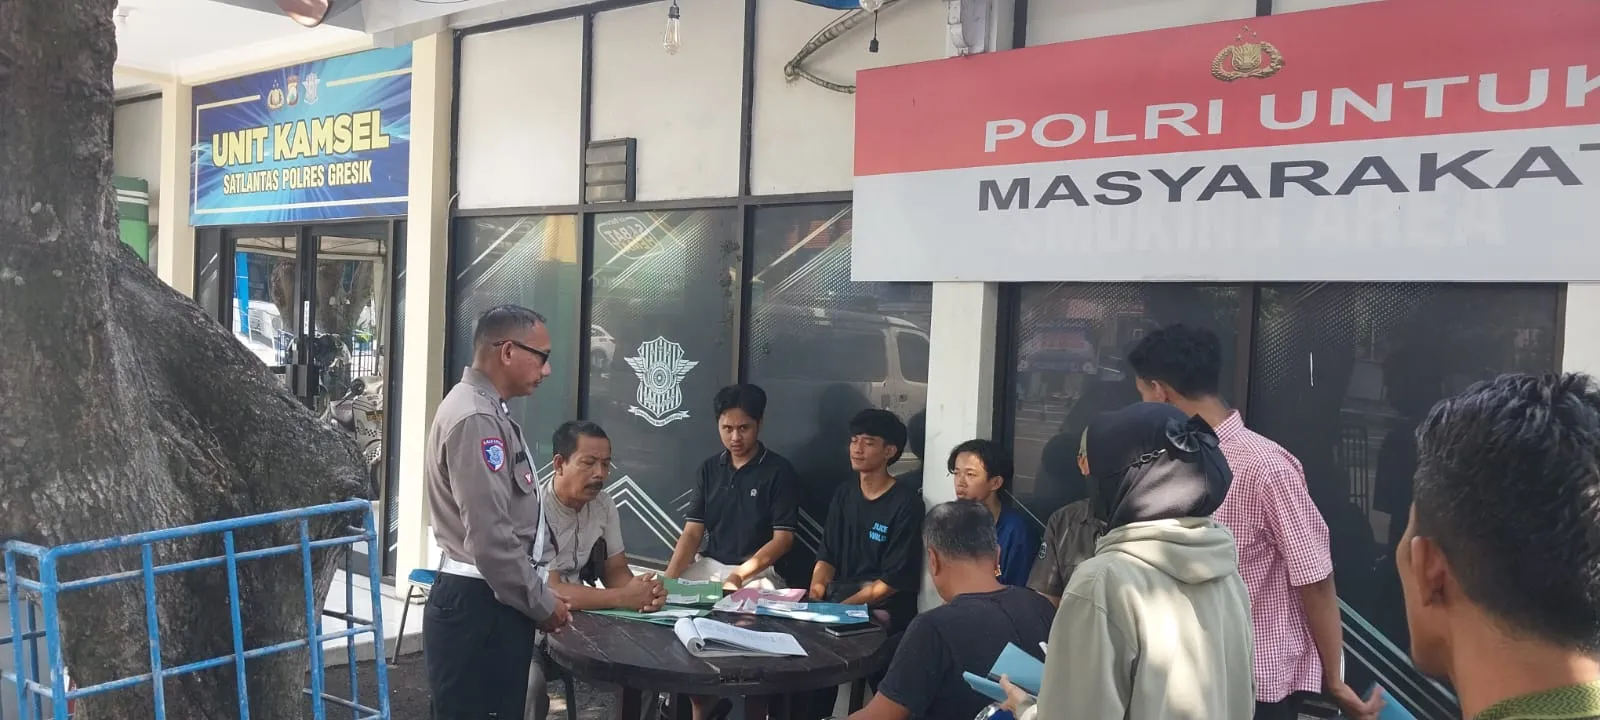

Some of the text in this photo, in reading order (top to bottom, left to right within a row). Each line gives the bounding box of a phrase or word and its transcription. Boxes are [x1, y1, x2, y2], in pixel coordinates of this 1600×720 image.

[211, 108, 391, 168] UNIT KAMSEL
[984, 98, 1223, 153] POLRI
[223, 160, 373, 195] SATLANTAS POLRES GRESIK
[978, 142, 1600, 212] MASYARAKA
